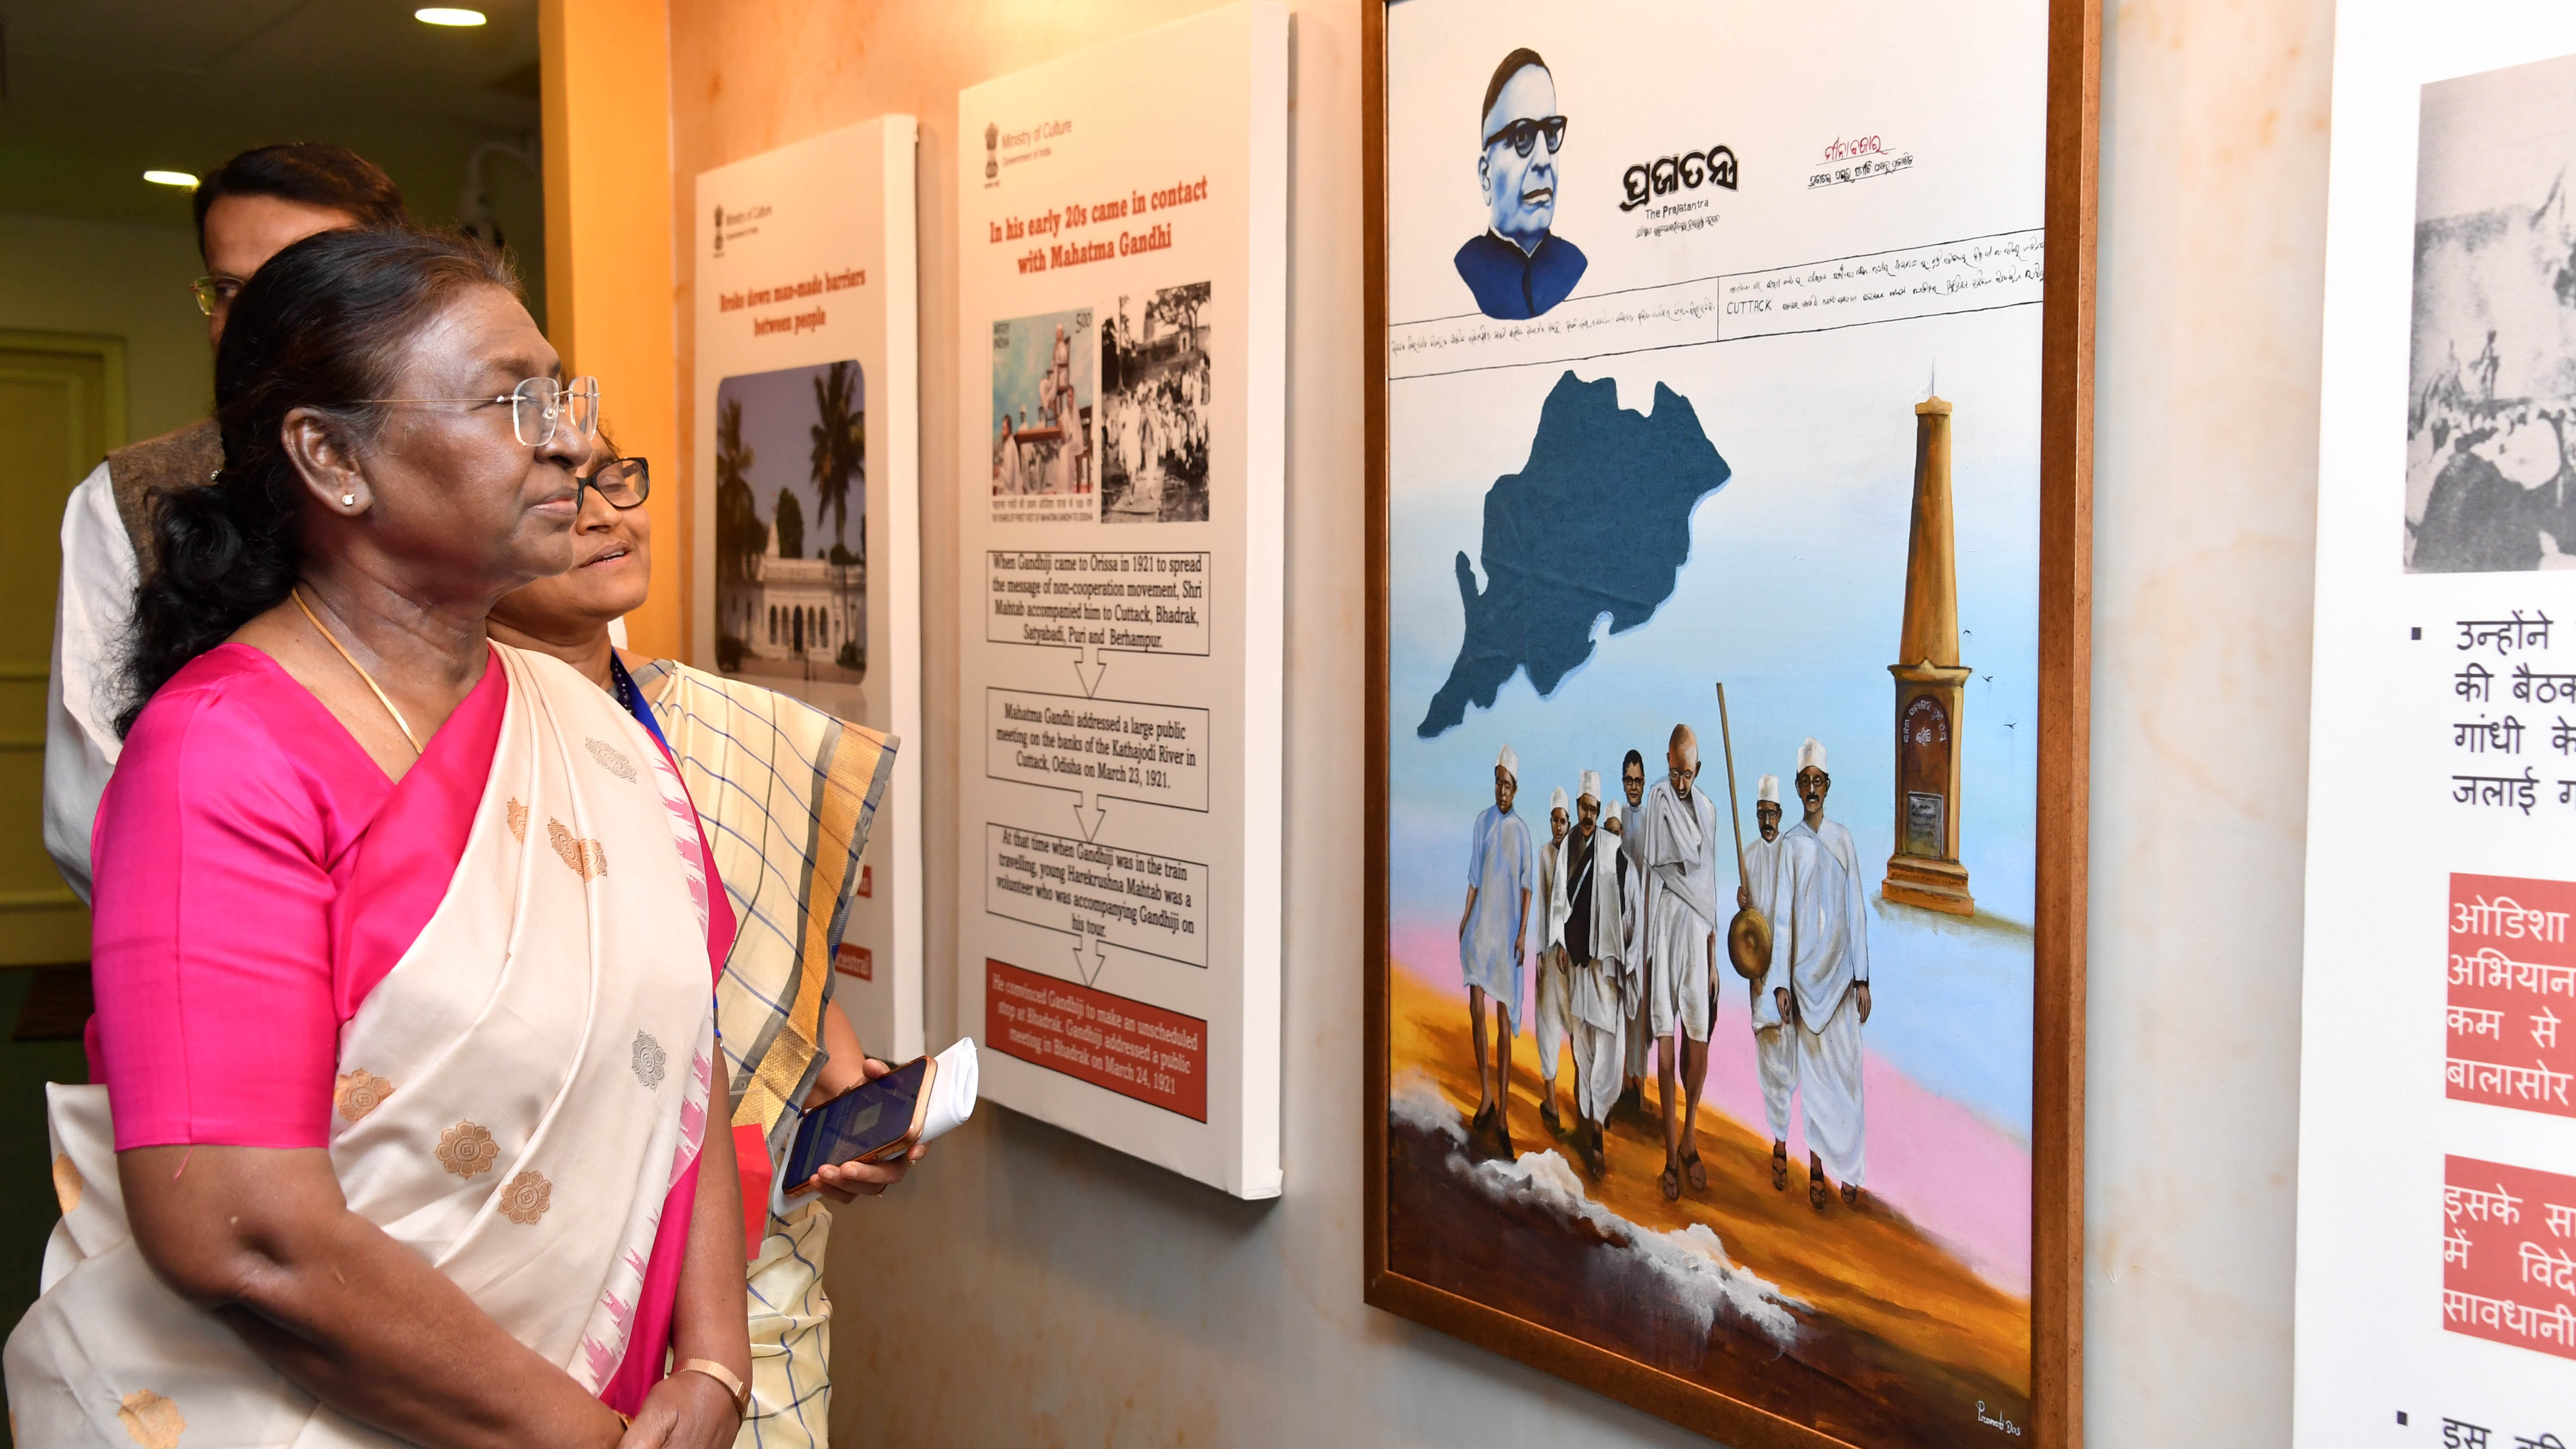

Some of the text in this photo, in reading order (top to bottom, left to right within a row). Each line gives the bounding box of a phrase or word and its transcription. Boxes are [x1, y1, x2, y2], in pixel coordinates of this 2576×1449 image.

[1002, 119, 1072, 149] Ministry of Culture
[990, 175, 1208, 244] In his early 20s came in contact
[1646, 209, 1660, 219] The
[1018, 223, 1171, 275] with Mahatma Gandhi
[748, 289, 771, 307] down
[774, 275, 822, 303] man-made
[826, 268, 866, 292] barriers
[1727, 299, 1771, 314] CUTTACK
[754, 306, 825, 336] between people
[993, 553, 1202, 577] When Gandhiji came to Orissa in 1921 to spread
[992, 577, 1202, 601] the message of non-cooperation movement, Shri
[995, 600, 1199, 627] Mahtab accompanied him to Cuttack, Bhadrak,
[2456, 609, 2554, 656] उन्होंने
[1023, 625, 1162, 652] Satyabadi, Puri and Berhampur.
[2455, 663, 2494, 702] की
[1004, 703, 1186, 741] Mahatma Gandhi addressed a large public
[2453, 713, 2526, 754] गांधी
[996, 728, 1196, 766] meeting on the banks of the Kathajodi River in
[1016, 751, 1171, 788] Cuttack, Odisha on March 23, 1921.
[2452, 766, 2540, 816] जलाई
[1003, 830, 1187, 880] At that time when Gandhiji was in the train
[999, 853, 1191, 907] travelling, young Harekrushna Mahtab was a
[997, 875, 1194, 934] volunteer who was accompanying Gandhiji on
[1071, 913, 1107, 937] his tour.
[2451, 894, 2570, 943] ओडिशा
[2447, 947, 2576, 998] अभियान
[993, 973, 1198, 1050] He convinced Gandhiji to make an unscheduled
[2446, 1005, 2561, 1048] कम से
[998, 1001, 1190, 1074] stop at Bhadrak. Gandhiji addressed a public
[1009, 1028, 1176, 1095] meeting in Bhadrak on March 24, 1921
[2445, 1058, 2574, 1107] बालासोर
[2444, 1184, 2523, 1225] इसके
[2443, 1228, 2472, 1269] में
[2443, 1287, 2576, 1347] सावधानी
